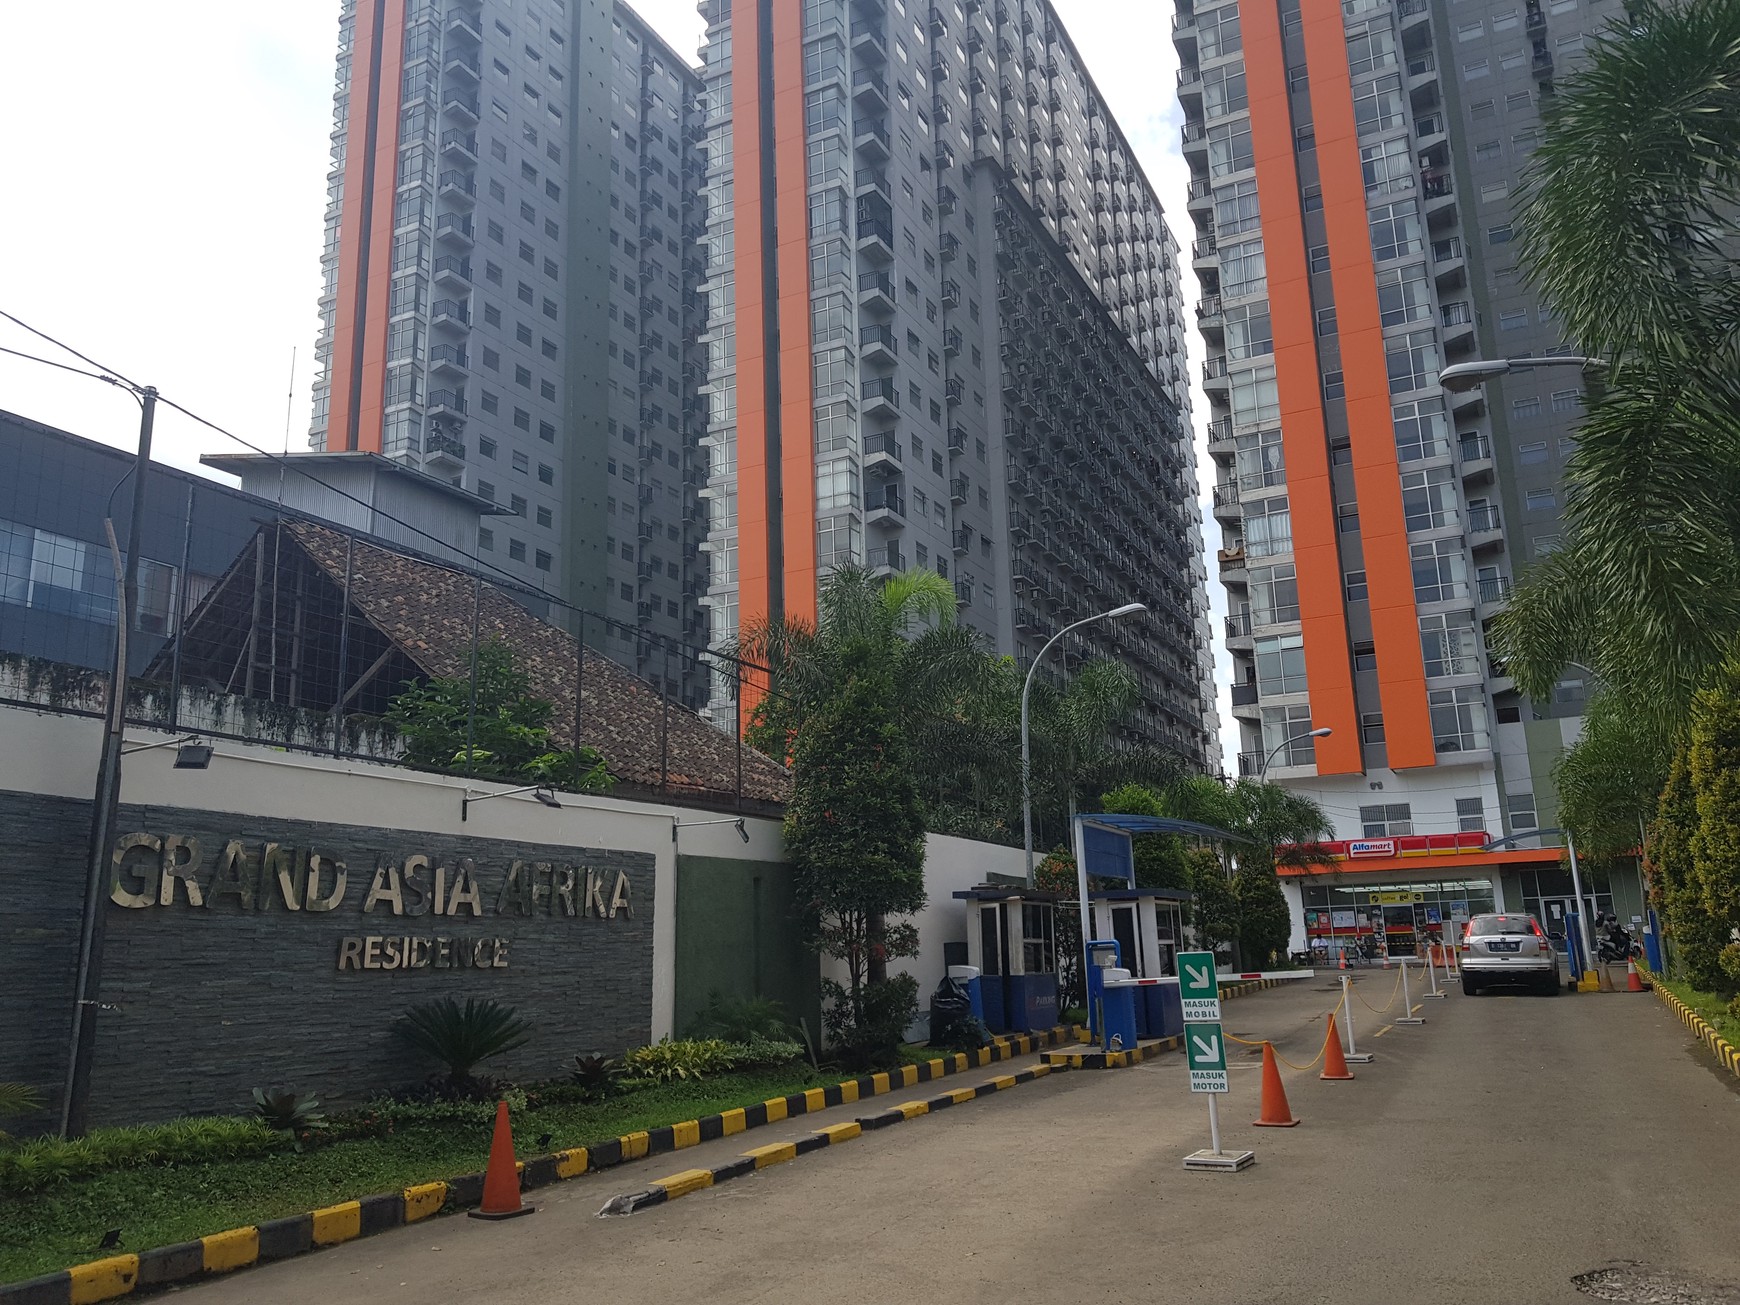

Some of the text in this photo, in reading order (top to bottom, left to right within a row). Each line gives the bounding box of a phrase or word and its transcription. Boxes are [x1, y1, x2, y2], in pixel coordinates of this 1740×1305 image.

[1352, 842, 1392, 851] Alfamart
[110, 832, 635, 919] GRAND ASIA AFRIKA
[338, 936, 511, 970] RESIDENCE
[1184, 1000, 1217, 1008] MASUK
[1185, 1010, 1218, 1018] MOBIL
[1192, 1072, 1225, 1080] MASUK
[1193, 1082, 1226, 1090] MOTOR
